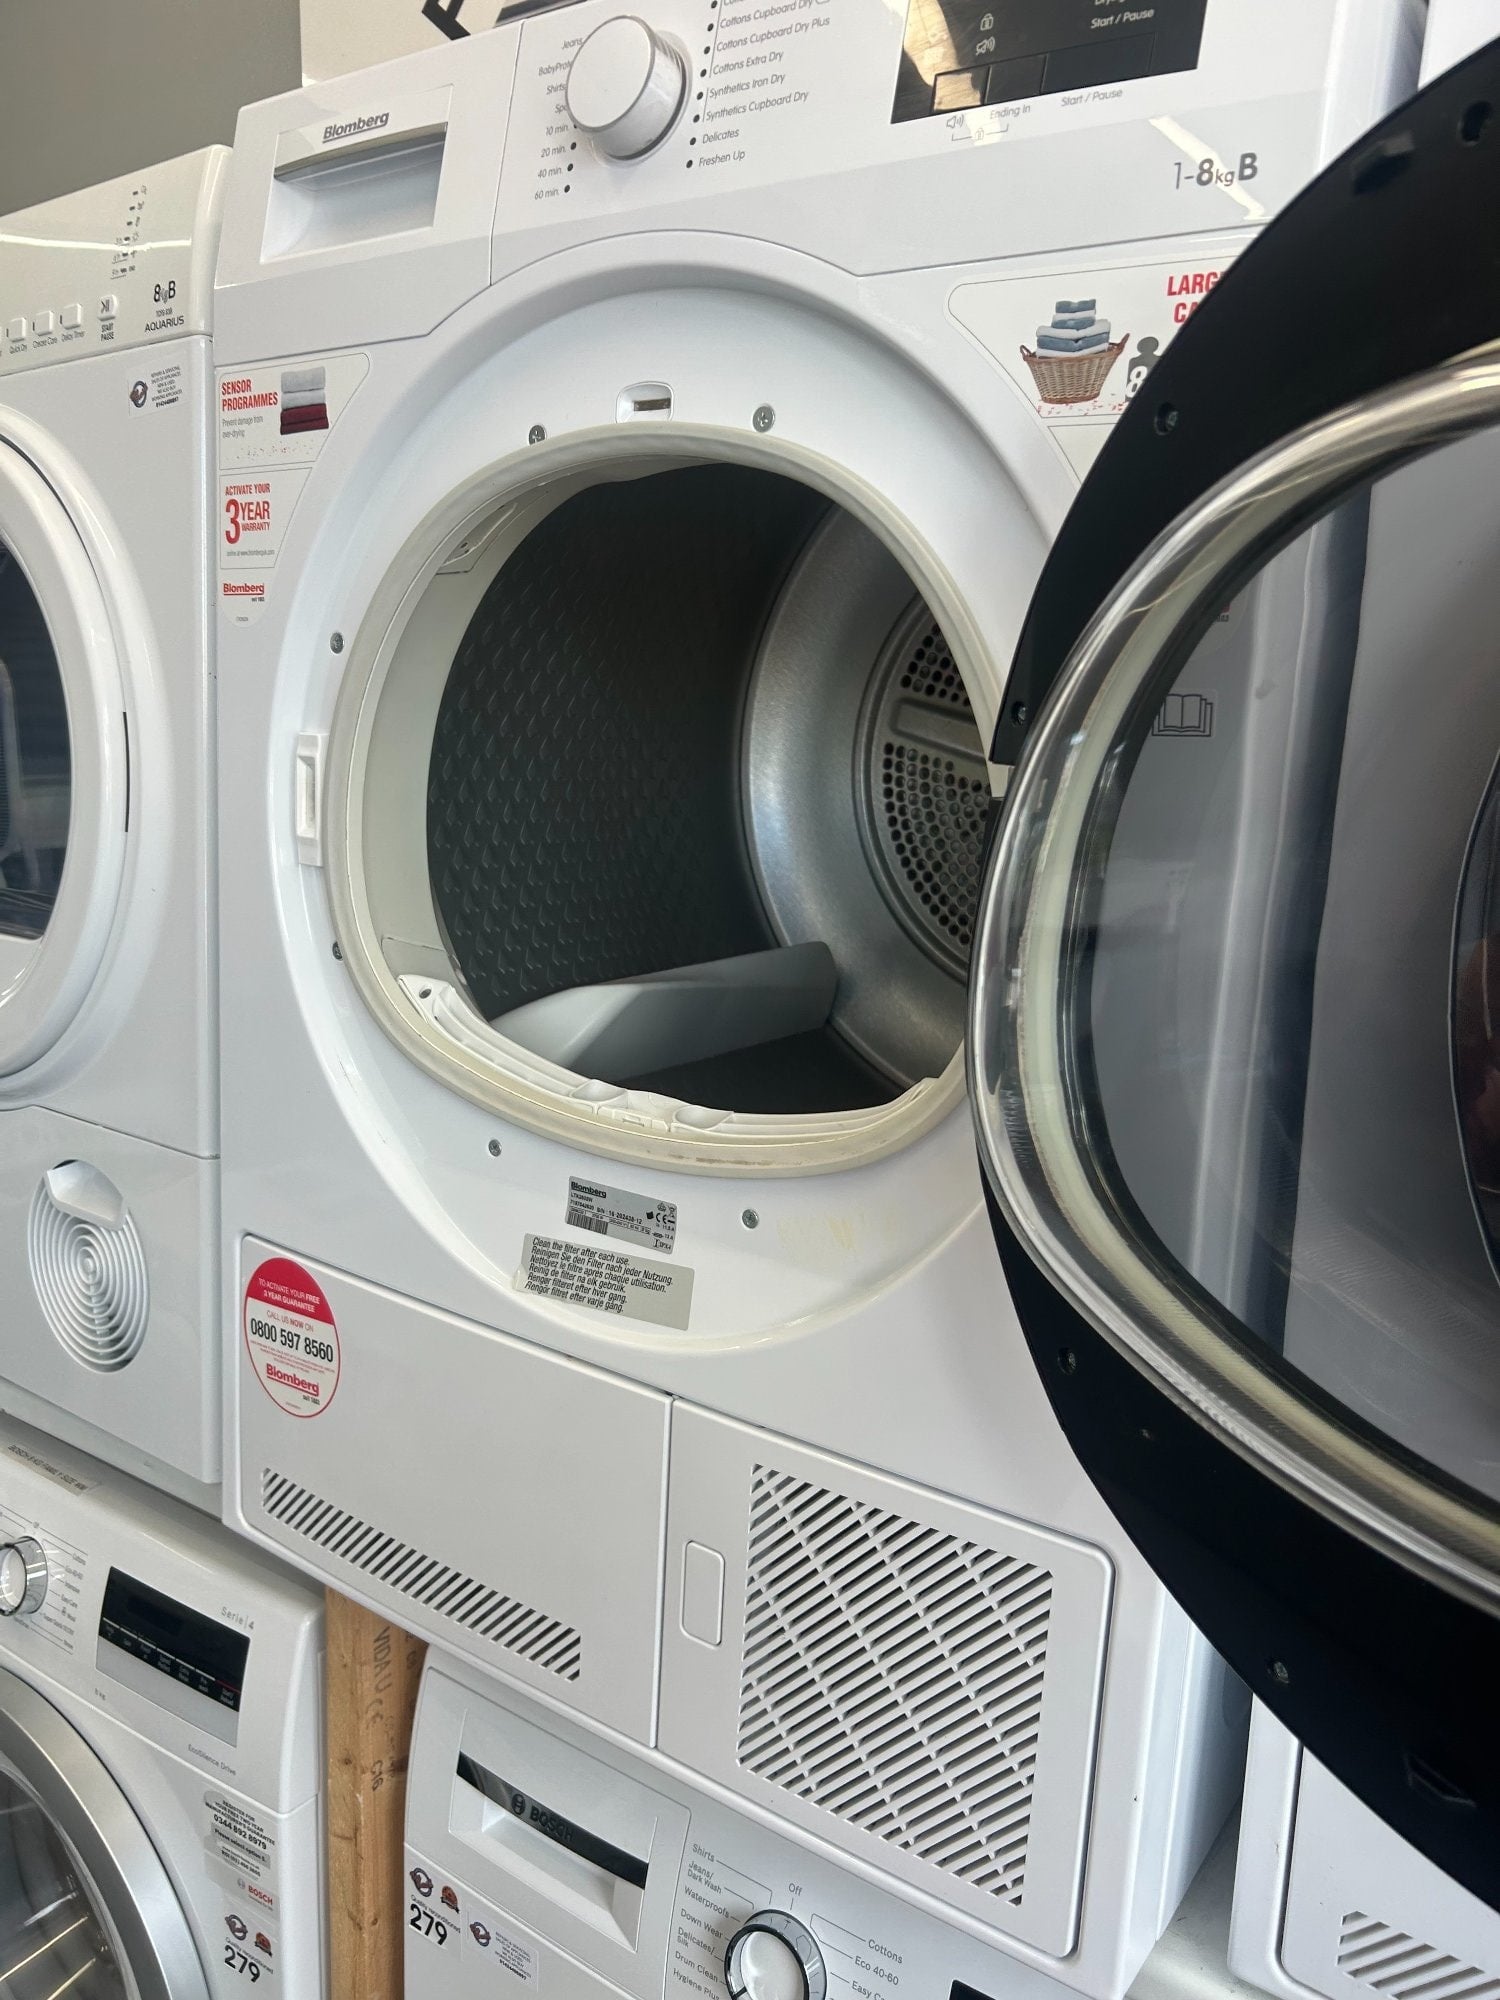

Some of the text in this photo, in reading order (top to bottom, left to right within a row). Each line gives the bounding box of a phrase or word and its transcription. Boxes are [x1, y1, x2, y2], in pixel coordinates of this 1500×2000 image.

[720, 11, 751, 30] Cottons
[753, 1, 797, 22] Cupboard
[1091, 15, 1114, 29] Start
[1122, 8, 1155, 23] Pause
[716, 17, 831, 53] Cottons Cupboard Dry Plus
[712, 50, 785, 76] Cottons Extra Dry
[708, 73, 786, 99] Synthetics Iron Dry
[1060, 94, 1084, 108] Start
[1091, 88, 1123, 102] Pause
[705, 90, 809, 123] Synthetics Cupboard Dry
[989, 104, 1031, 121] Ending In
[322, 112, 390, 144] Blomberg
[545, 127, 554, 136] 10
[702, 128, 740, 145] Delicates
[541, 148, 551, 158] 20
[698, 150, 746, 168] Freshen Up
[537, 169, 547, 179] 40
[1238, 152, 1259, 182] B
[534, 190, 544, 200] 60
[1166, 271, 1226, 297] LARG
[145, 315, 185, 333] AQUARIUS
[221, 378, 252, 396] SENSOR
[221, 391, 279, 412] PROGRAMMES
[225, 482, 271, 496] ACTIVATE YOUR
[225, 498, 271, 545] 3 YEAR
[241, 521, 271, 532] WARRANTY
[223, 582, 265, 596] Blomberg
[570, 1181, 607, 1199] Blomberg
[532, 1236, 551, 1249] Clean
[552, 1240, 563, 1251] the
[564, 1243, 581, 1255] filter
[581, 1247, 598, 1258] after
[597, 1251, 616, 1263] each
[528, 1262, 626, 1293] Reinig de filter na elk gebruik.
[529, 1254, 559, 1268] Nettoyez
[559, 1260, 567, 1270] le
[566, 1262, 584, 1274] filtre
[604, 1271, 630, 1285] chaque
[630, 1277, 667, 1293] utilisation.
[531, 1245, 674, 1287] Reinigen Sie den Filter nach jeder Nutzung.
[266, 1281, 289, 1295] ACTIVATE
[289, 1288, 306, 1299] YOUR
[305, 1293, 321, 1305] FREE
[267, 1291, 282, 1301] YEAR
[282, 1295, 316, 1313] GUARANTEE
[569, 1292, 587, 1303] efter
[574, 1284, 592, 1295] efter
[591, 1287, 609, 1298] hver
[608, 1292, 628, 1305] gang.
[266, 1309, 280, 1321] CALL
[289, 1318, 304, 1329] NOW
[250, 1318, 278, 1343] 0800
[280, 1327, 302, 1352] 597
[304, 1337, 334, 1364] 8560
[266, 1362, 320, 1397] Blomberg
[221, 1605, 244, 1625] Serie
[213, 1814, 233, 1830] 0344
[233, 1825, 248, 1839] 892
[530, 1805, 574, 1842] BOSCH
[692, 1843, 715, 1863] Shirts
[687, 1868, 722, 1894] Dark Wash
[688, 1861, 714, 1880] Jeans/
[248, 1885, 273, 1906] BOSCH
[788, 1883, 803, 1896] Off
[684, 1885, 730, 1919] Waterproofs
[410, 1903, 448, 1946] 279
[680, 1908, 723, 1939] Down Wear
[677, 1935, 689, 1949] Silk
[678, 1926, 716, 1956] Delicates/
[868, 1938, 904, 1964] Cottons
[224, 1944, 261, 1983] 279
[675, 1950, 719, 1982] Drum Clean
[854, 1955, 900, 1986] Eco 40-60
[673, 1967, 703, 1992] Hygiene
[851, 1980, 873, 1998] Easy
